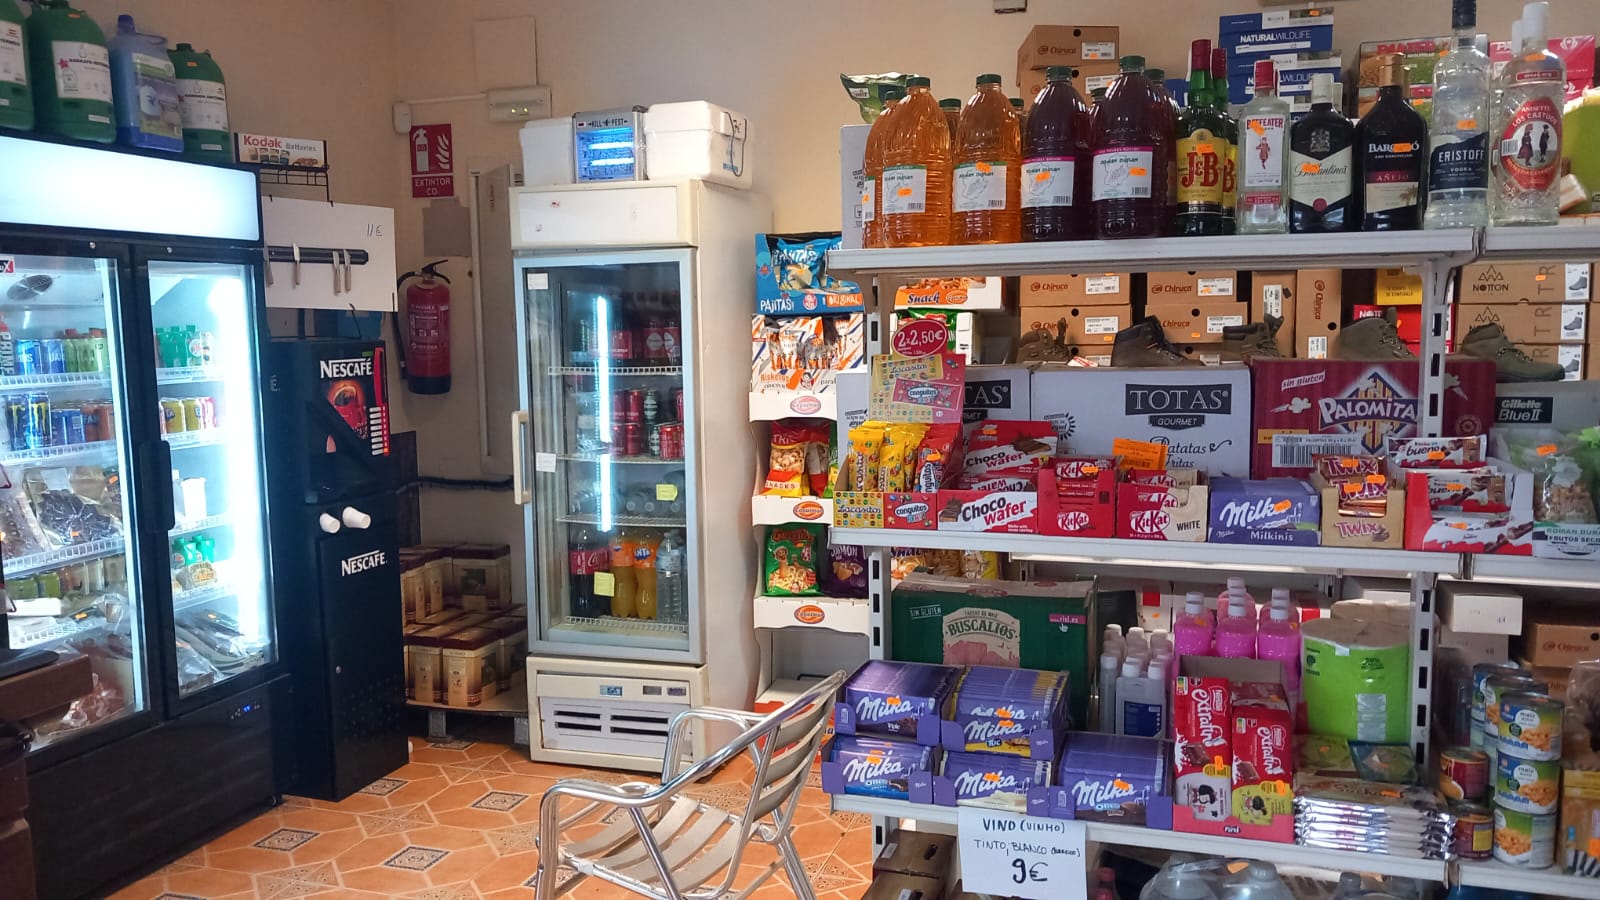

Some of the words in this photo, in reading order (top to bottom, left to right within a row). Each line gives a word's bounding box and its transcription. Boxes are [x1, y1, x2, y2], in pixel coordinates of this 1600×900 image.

[1246, 118, 1284, 129] BFEATER
[243, 135, 282, 149] Kodak
[285, 142, 317, 152] Batteries
[1438, 149, 1485, 163] ERISTOFF
[1181, 151, 1219, 188] J&B
[415, 177, 451, 188] EXTINTOR
[1042, 282, 1069, 291] Chiruca
[1164, 284, 1192, 293] Chiruca
[1472, 283, 1509, 292] NOTTON
[906, 291, 941, 304] Snack
[1315, 293, 1324, 320] Chiruca
[1162, 320, 1191, 328] Chiruca
[320, 358, 373, 379] NESCAFÉ
[1281, 380, 1295, 388] sin
[1129, 389, 1223, 410] TOTAS
[1501, 400, 1542, 409] Gillette
[1157, 418, 1198, 426] GOURMET
[966, 451, 1006, 467] Choco
[985, 452, 1023, 468] wafer
[837, 504, 881, 515] Lacasitos
[896, 503, 928, 516] conguitos
[962, 497, 1006, 522] Choco
[984, 500, 1027, 526] wafer
[1219, 497, 1287, 528] Milk
[1061, 512, 1088, 530] KitKat
[1135, 510, 1168, 533] KitKat
[1176, 520, 1201, 532] WHITE
[1250, 530, 1294, 541] Milkinis
[843, 753, 904, 782] Milka
[983, 818, 1016, 832] VINO
[1020, 819, 1066, 834] (VINHO)
[1011, 841, 1048, 855] BLANCO
[1011, 858, 1049, 884] 9€
